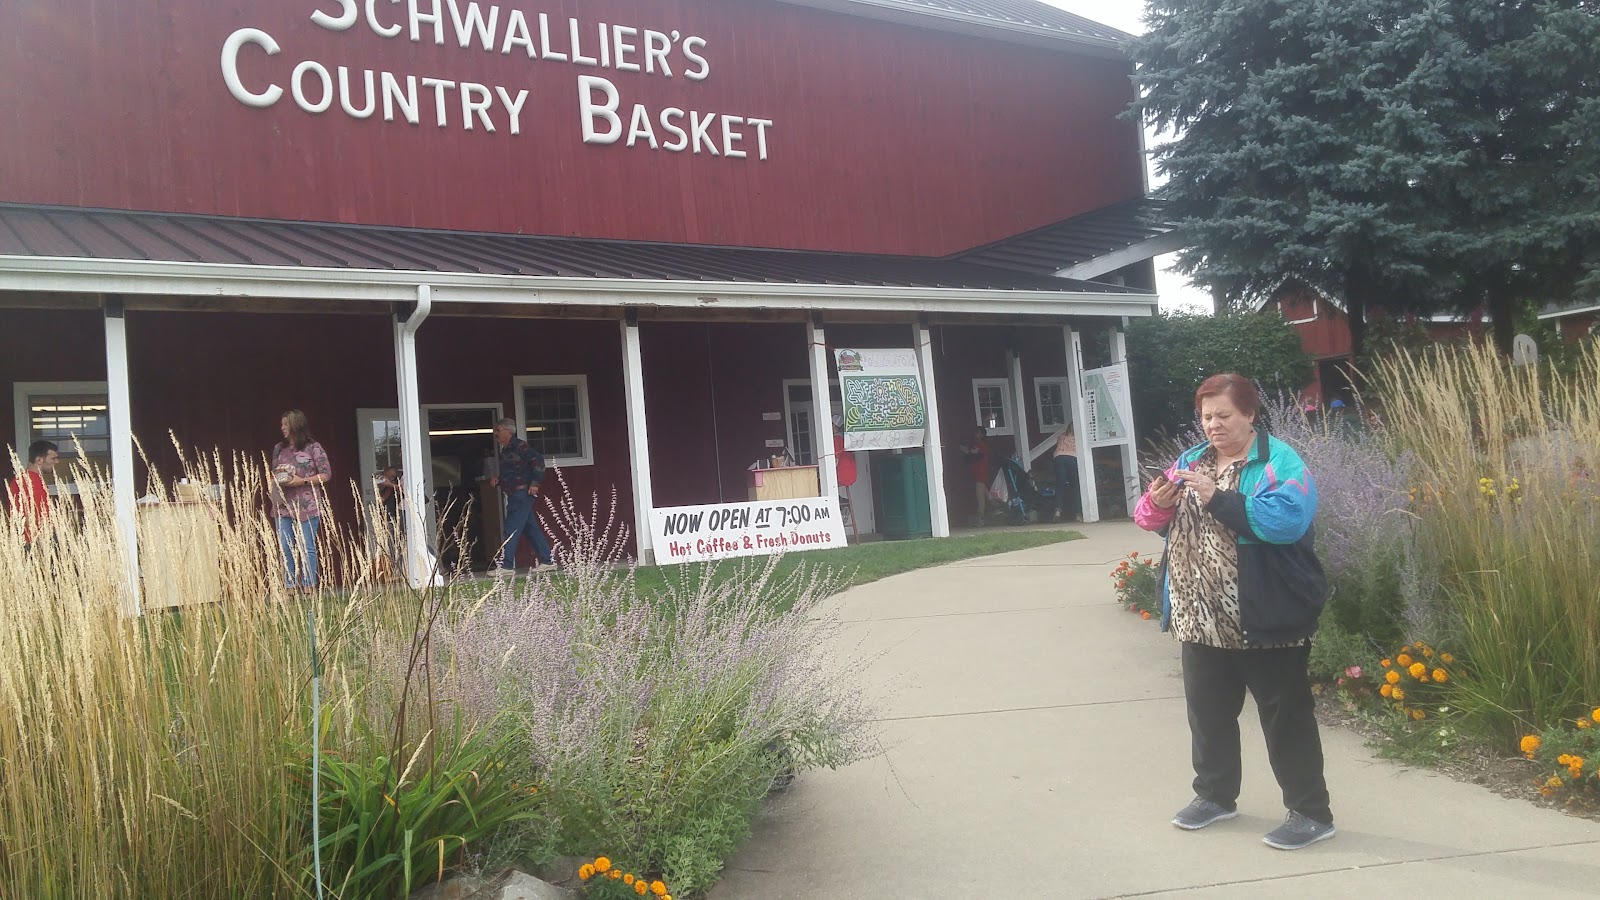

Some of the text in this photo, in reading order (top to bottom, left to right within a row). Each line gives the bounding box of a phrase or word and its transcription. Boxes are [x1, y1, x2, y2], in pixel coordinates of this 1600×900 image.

[220, 27, 773, 161] COUNTRY BASKET
[663, 504, 830, 536] NOW OPEN AT 7:00 AM
[669, 530, 832, 557] Hot Coffee & Fresh Donuts
